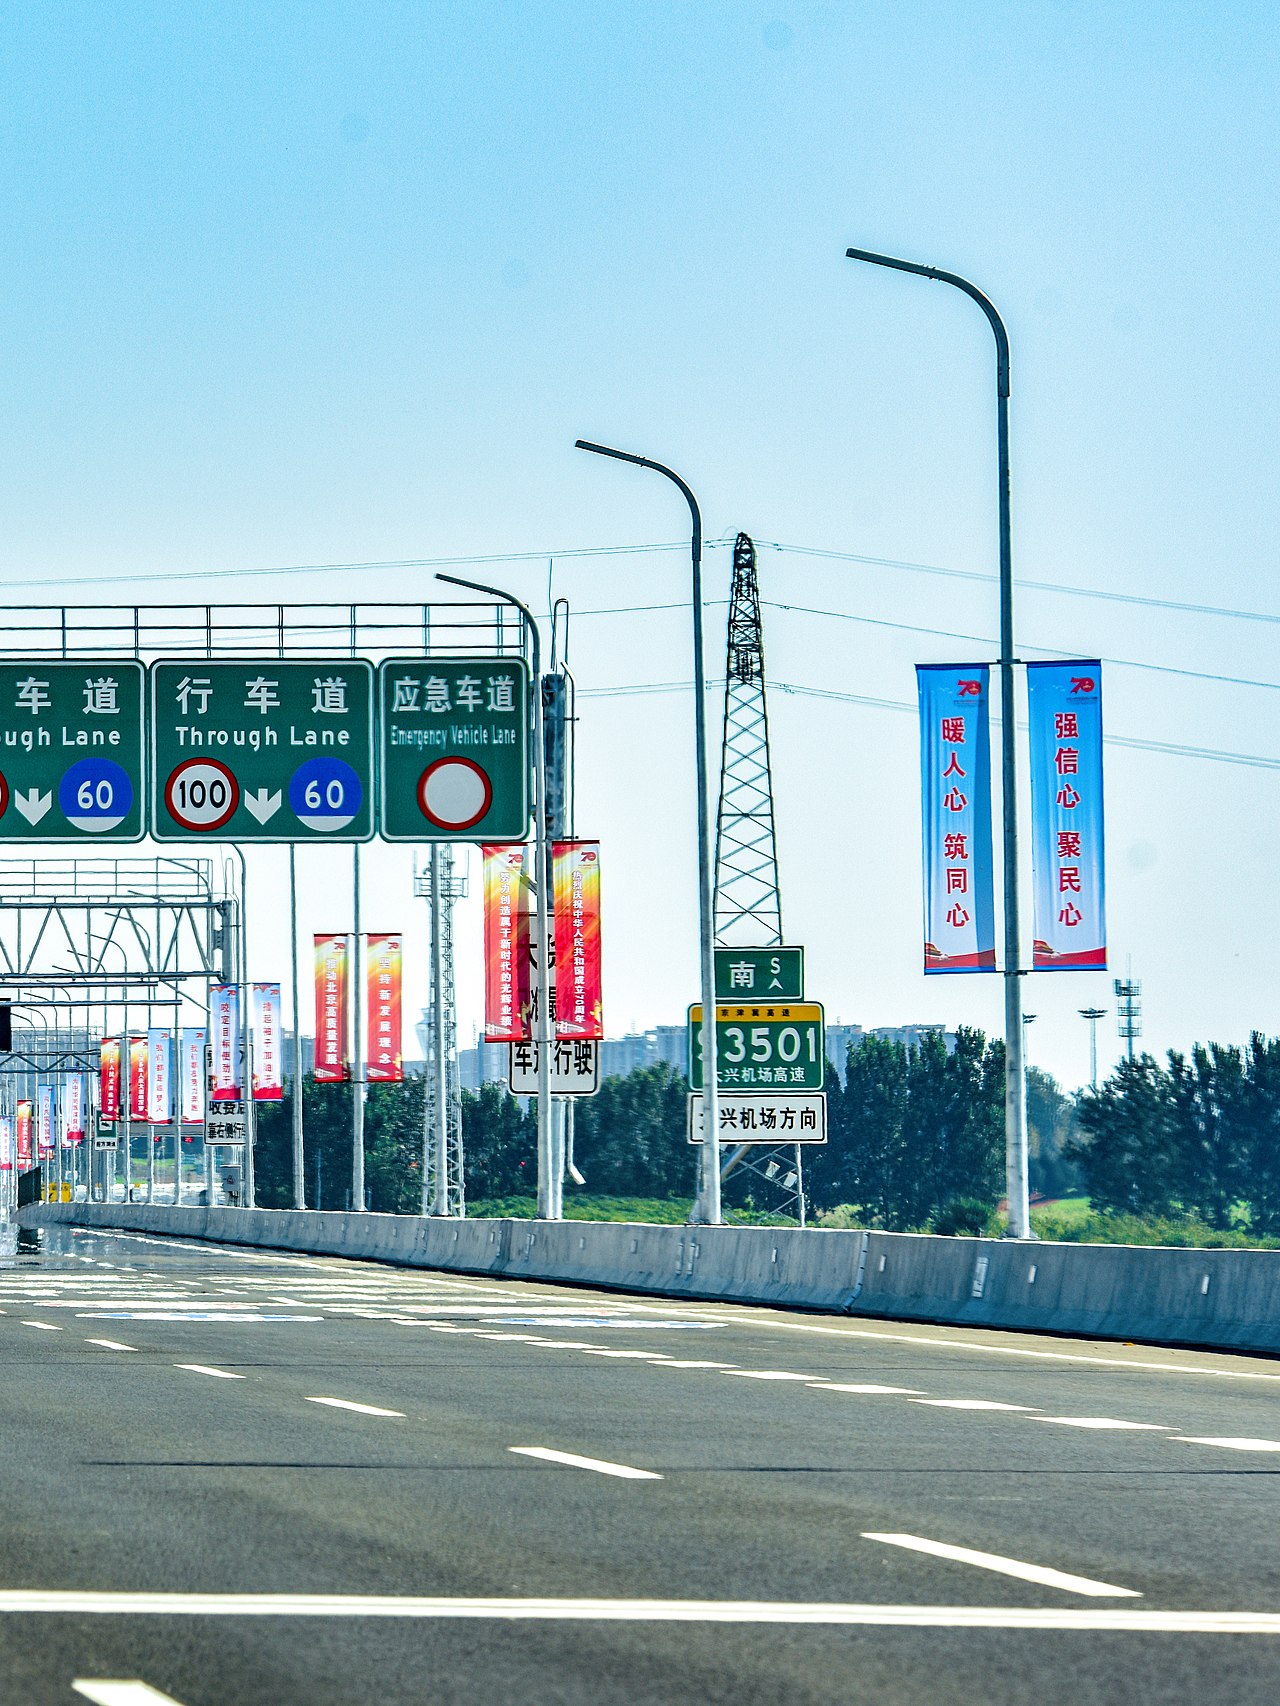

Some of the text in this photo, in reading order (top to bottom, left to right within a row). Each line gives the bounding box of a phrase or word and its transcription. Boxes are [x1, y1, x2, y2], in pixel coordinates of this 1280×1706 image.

[175, 677, 350, 715] 行车道
[391, 675, 516, 713] 应急车道
[62, 727, 121, 747] Lane
[175, 727, 350, 752] Through Lane
[390, 724, 516, 750] Emergency Vehicle Lane
[76, 781, 114, 809] 60
[178, 781, 227, 810] 100
[304, 781, 344, 809] 60
[500, 872, 512, 1027] 努力创造属于新时代的光辉业绩
[729, 961, 756, 989] 南
[325, 958, 338, 1065] 推动北京高质量发展
[378, 958, 392, 1064] 坚持新发展理念
[721, 1008, 790, 1017] 京津冀高速
[207, 1122, 246, 1139] 靠右侧行
[699, 1106, 817, 1130] 兴机场方向
